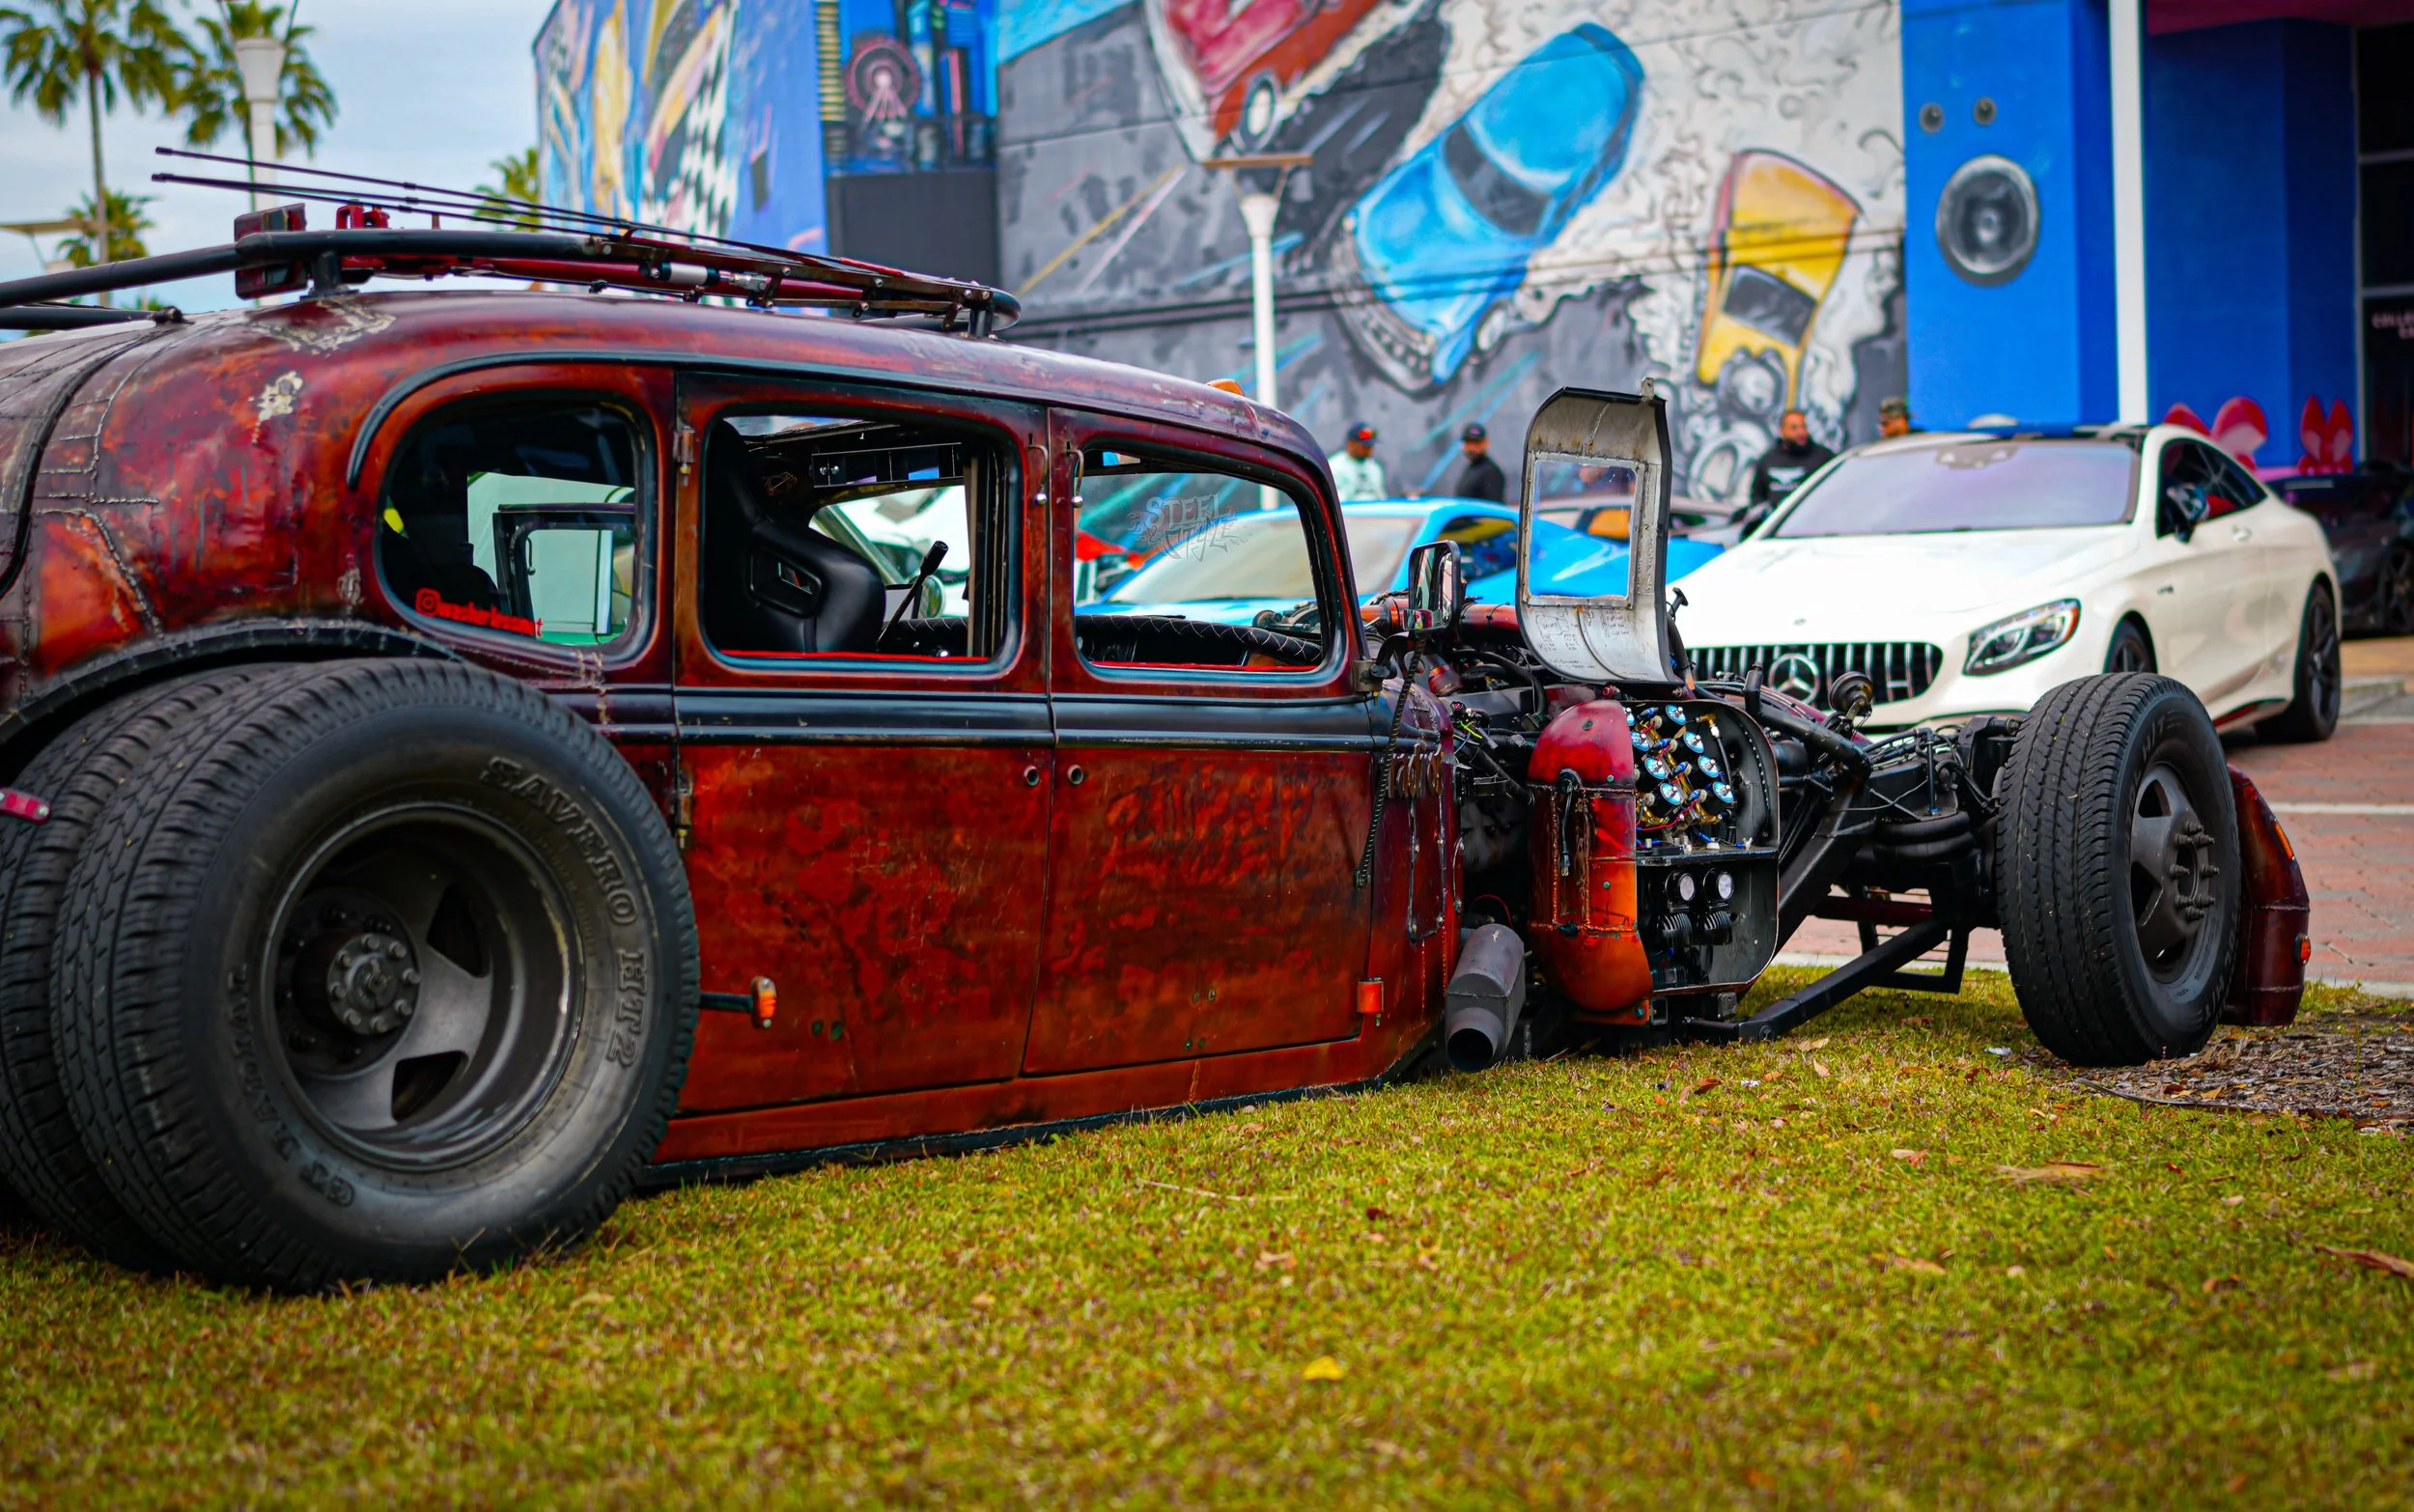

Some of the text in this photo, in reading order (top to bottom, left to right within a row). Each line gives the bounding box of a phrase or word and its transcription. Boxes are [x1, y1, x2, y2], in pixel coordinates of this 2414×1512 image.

[1145, 493, 1224, 529] STEEL
[1148, 518, 1241, 562] & STYLE
[480, 756, 638, 925] SAVERO
[606, 947, 648, 1069] HT2
